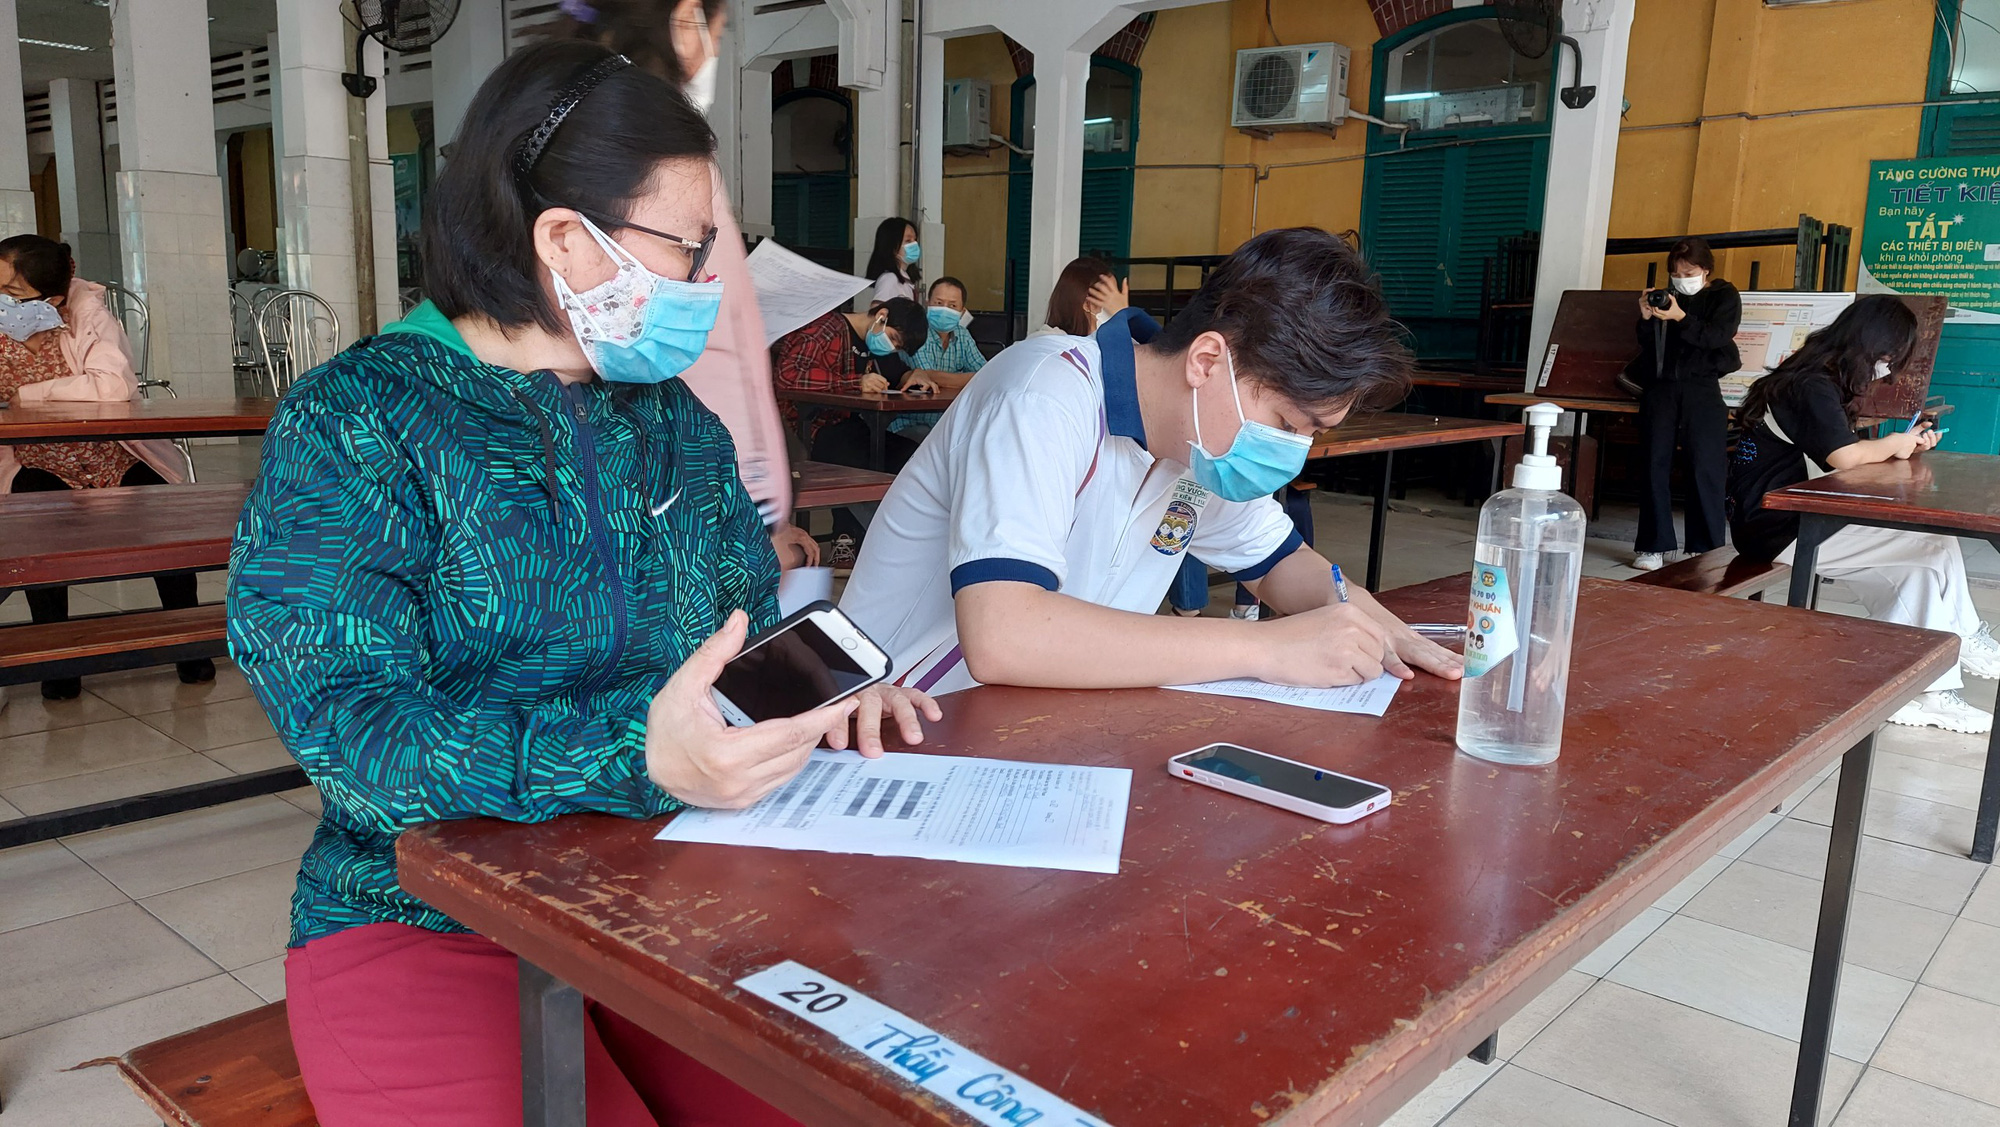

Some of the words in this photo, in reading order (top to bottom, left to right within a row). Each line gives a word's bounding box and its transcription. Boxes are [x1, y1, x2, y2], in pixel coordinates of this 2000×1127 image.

[1878, 168, 1915, 181] TĂNG
[1918, 166, 1968, 179] CƯỜNG
[1889, 181, 1952, 204] TIẾT
[1879, 206, 1901, 217] Bạn
[1904, 206, 1925, 217] hãy
[1906, 212, 1954, 239] TẮT
[1881, 240, 1904, 251] CÁC
[1907, 237, 1939, 251] THIẾT
[1941, 241, 1953, 252] BỊ
[1955, 239, 1983, 252] ĐIỆN
[1879, 253, 1894, 262] khi
[1896, 254, 1906, 262] ra
[1908, 252, 1930, 262] khỏi
[1931, 252, 1963, 263] phòng
[778, 982, 848, 1013] 20
[864, 1023, 955, 1084] Thầy
